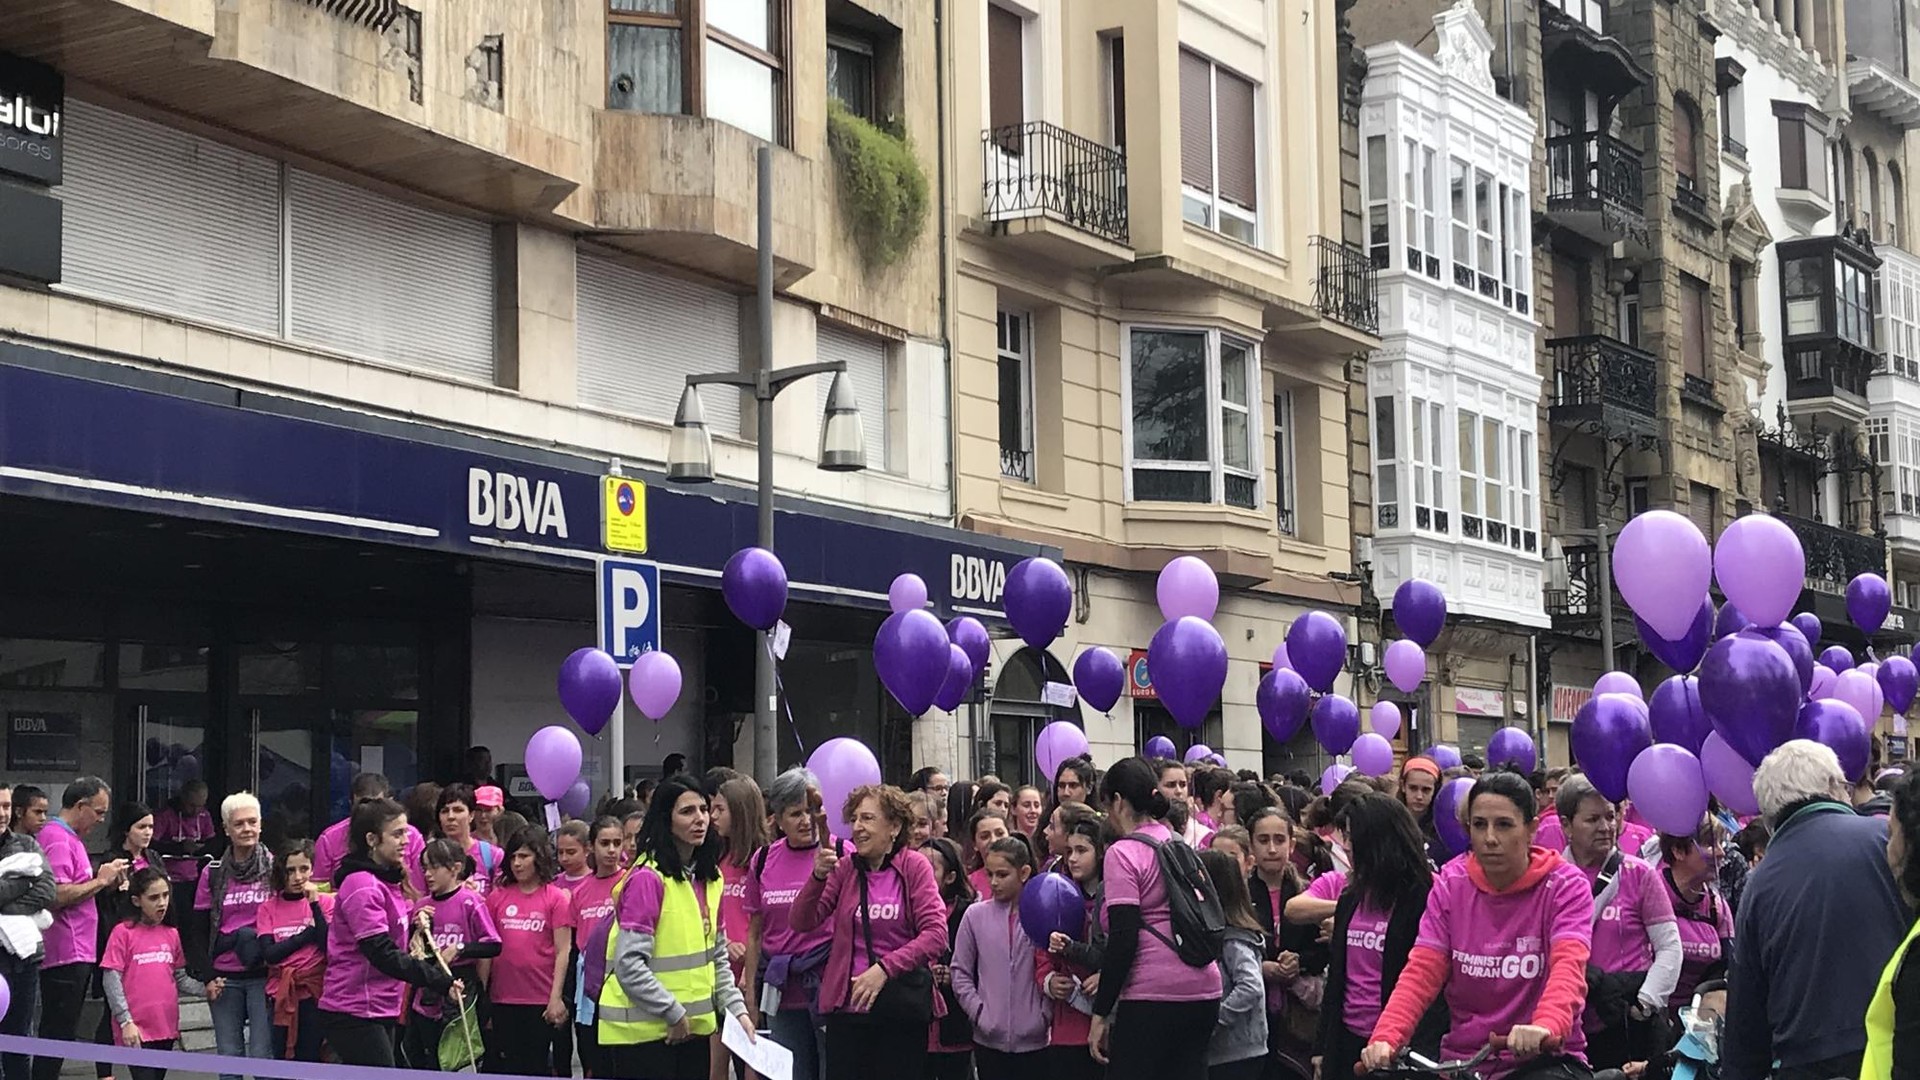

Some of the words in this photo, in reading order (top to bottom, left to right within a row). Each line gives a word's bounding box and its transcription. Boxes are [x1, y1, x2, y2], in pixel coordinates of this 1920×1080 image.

[468, 467, 568, 538] BBVA
[951, 553, 1007, 603] BBVA
[611, 568, 650, 657] P
[868, 903, 900, 920] GO!
[522, 919, 546, 932] GO!
[1452, 949, 1502, 967] FEMINIST
[1501, 953, 1545, 979] GO!
[1461, 963, 1501, 978] DURAN
